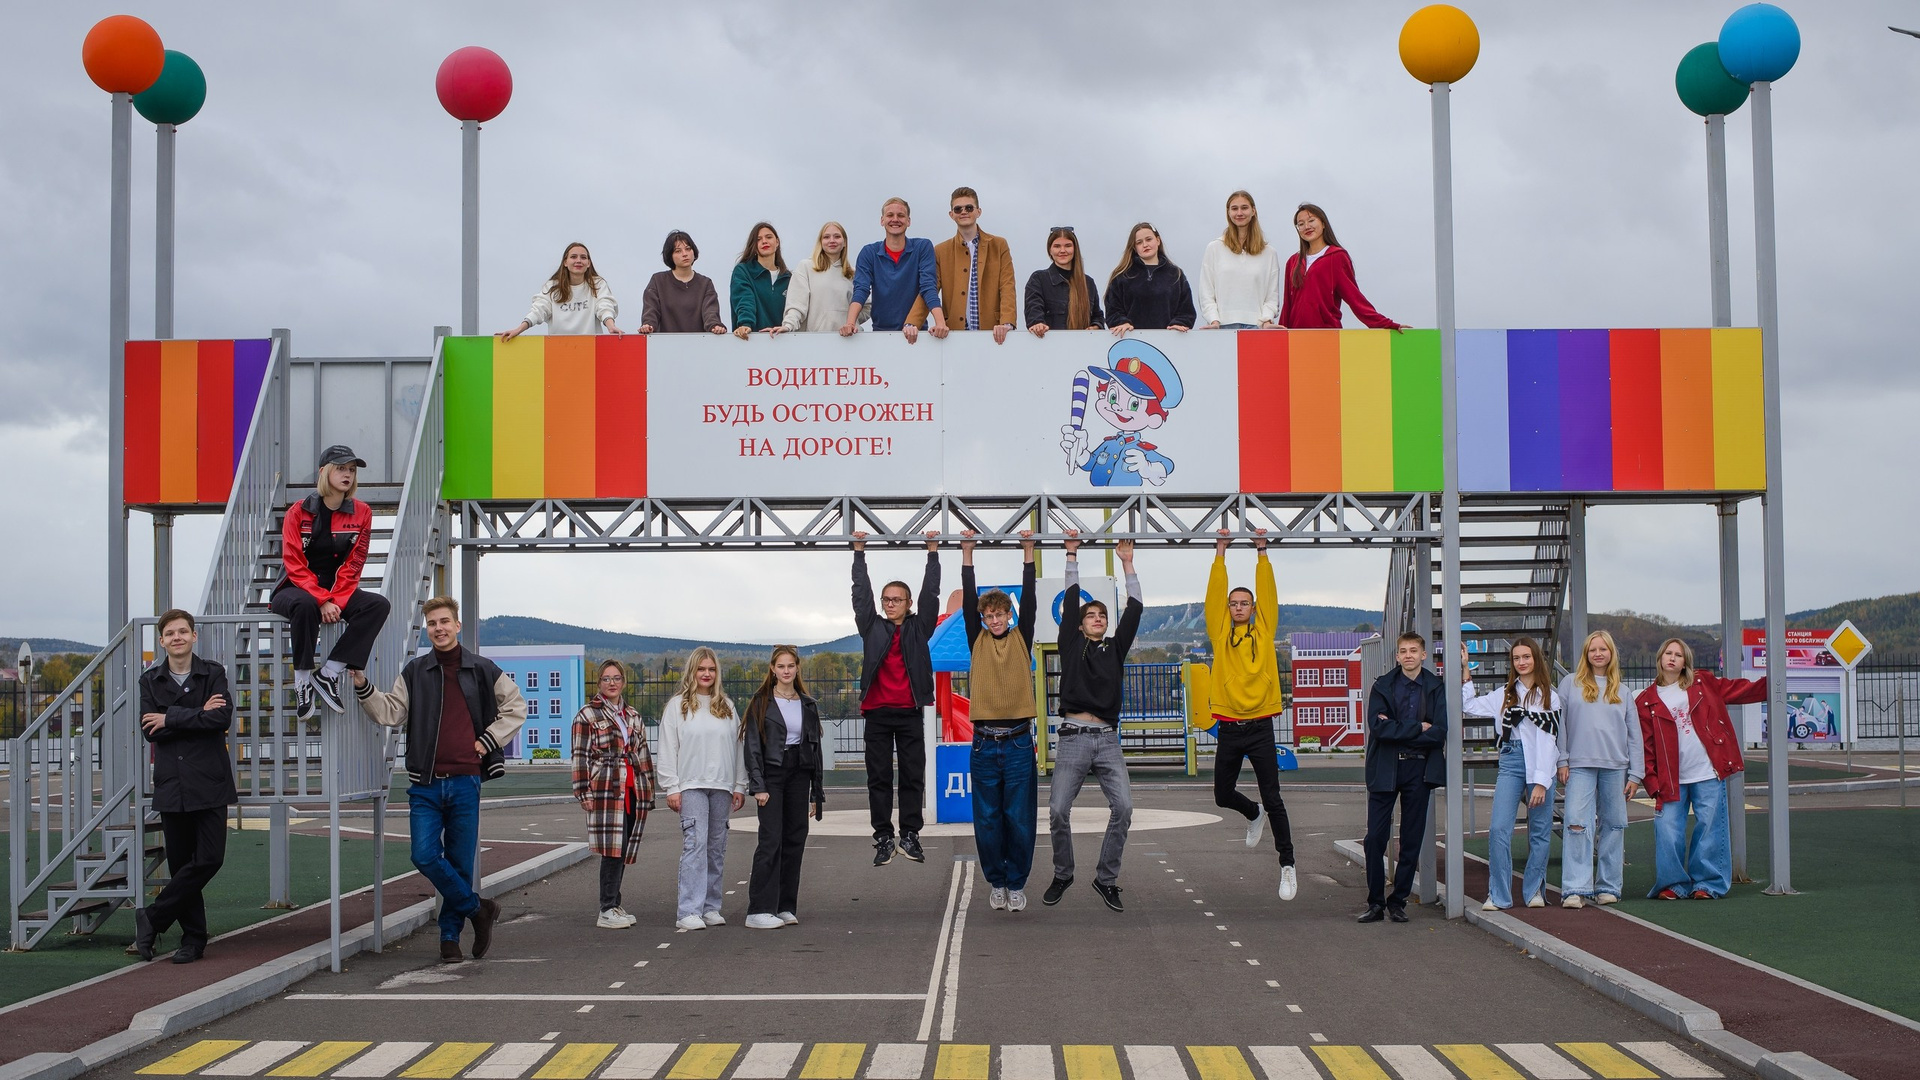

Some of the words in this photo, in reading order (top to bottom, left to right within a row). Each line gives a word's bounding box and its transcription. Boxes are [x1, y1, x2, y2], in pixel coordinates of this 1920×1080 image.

[560, 300, 588, 312] CUTE
[747, 367, 889, 390] ВОДИТЕЛЬ,
[702, 404, 765, 427] БУДЬ
[772, 403, 934, 423] ОСТОРОЖЕН
[739, 437, 776, 456] НА
[782, 436, 893, 460] ДОРОГЕ!
